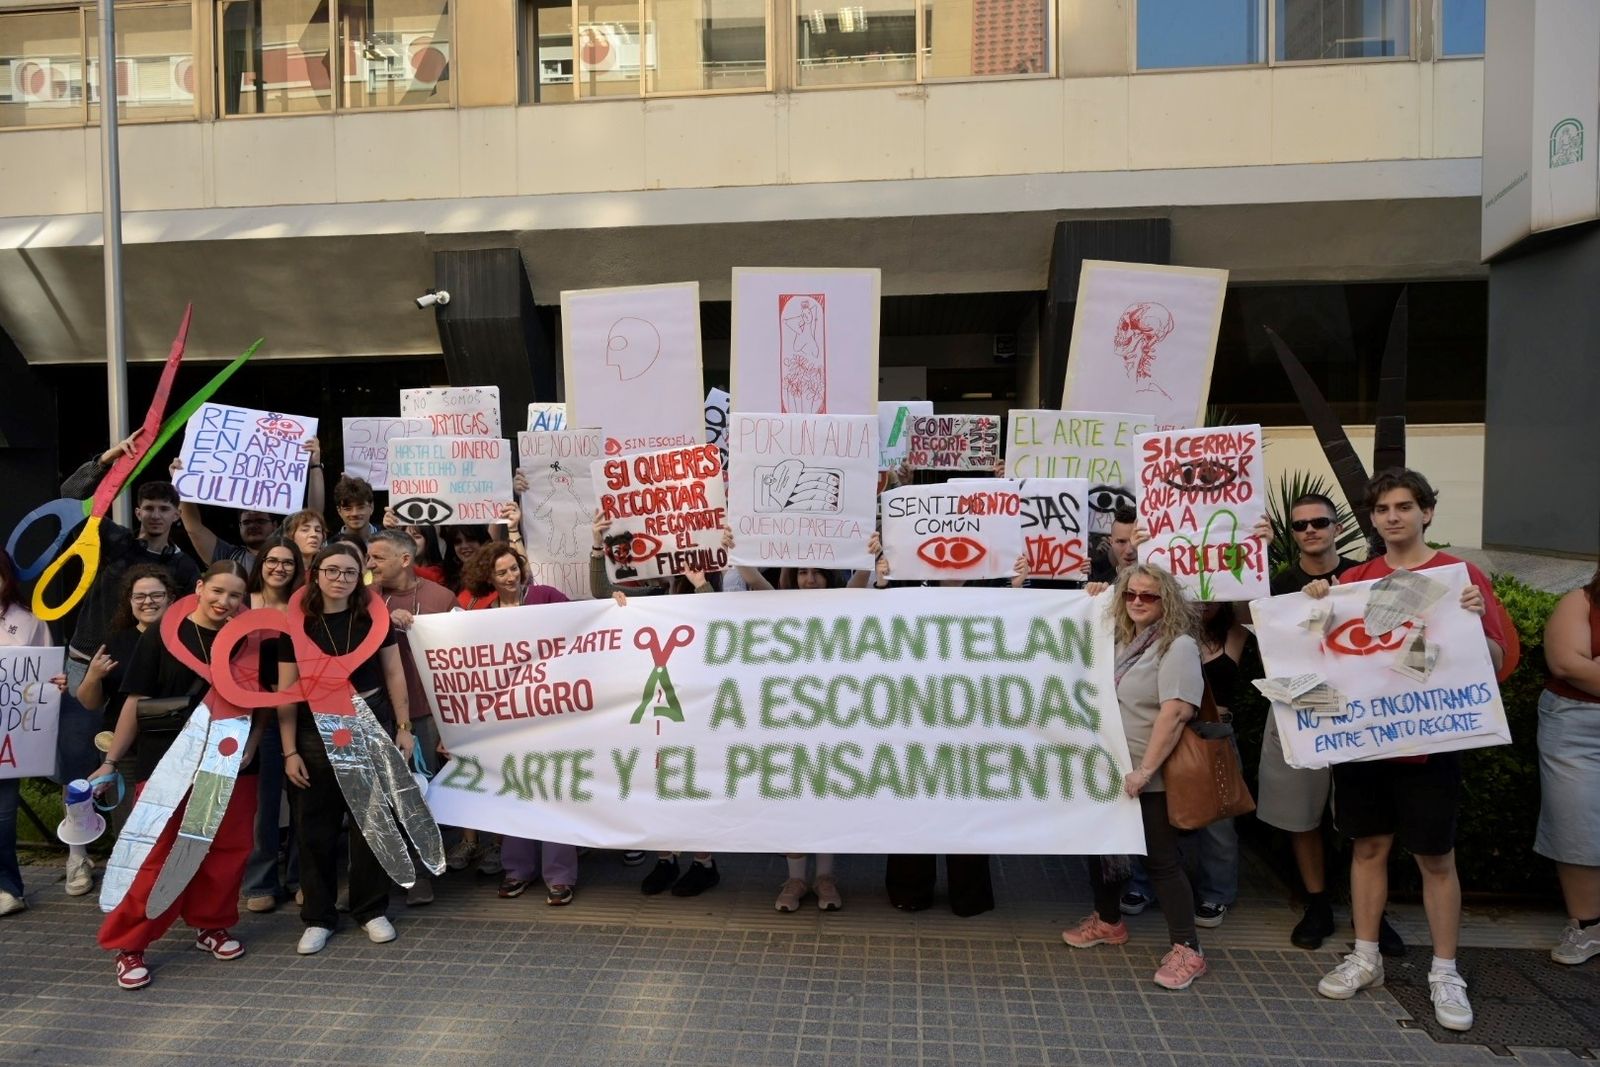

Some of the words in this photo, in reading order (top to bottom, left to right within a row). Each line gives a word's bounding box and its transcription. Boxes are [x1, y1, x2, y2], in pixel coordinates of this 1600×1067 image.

[414, 397, 426, 411] NO
[442, 392, 481, 406] SOMOS
[201, 407, 247, 431] RE
[350, 419, 423, 443] STOP
[428, 412, 489, 435] ORMIGAS
[914, 417, 954, 436] CON
[1014, 416, 1043, 446] EL
[1053, 418, 1105, 447] ARTE
[194, 430, 240, 451] EN
[245, 434, 308, 461] ARTE
[395, 445, 430, 459] HASTA
[433, 445, 446, 460] EL
[451, 440, 500, 460] DINERO
[520, 435, 546, 457] QUE
[551, 434, 572, 457] NO
[574, 434, 600, 457] NOS
[624, 438, 646, 450] SIN
[649, 434, 697, 448] ESCUELA
[740, 418, 784, 455] POR
[790, 419, 817, 456] UN
[823, 421, 871, 459] AULA
[911, 434, 968, 451] RECORTE
[1143, 436, 1171, 463] SI
[1174, 432, 1256, 459] CERRAIS
[187, 450, 233, 474] ES
[232, 453, 306, 482] BORRAR
[391, 461, 411, 477] QUE
[414, 462, 423, 477] TE
[604, 460, 630, 490] SI
[634, 444, 721, 485] QUIERES
[908, 451, 929, 466] NO
[932, 452, 963, 467] HAY
[176, 473, 292, 509] CULTURA
[392, 479, 439, 495] BOLSILLO
[450, 480, 493, 494] NECESITA
[600, 481, 709, 520] RECORTAR
[458, 499, 504, 520] DISEÑO
[645, 508, 726, 535] RECORTATE
[1147, 511, 1175, 539] VA
[1180, 505, 1198, 532] A
[739, 515, 771, 537] QUE
[773, 516, 795, 536] NO
[799, 517, 863, 539] PAREZCA
[914, 517, 980, 535] COMÚN
[675, 531, 698, 550] EL
[760, 541, 791, 560] UNA
[798, 542, 836, 561] LATA
[424, 640, 532, 670] ESCUELAS
[537, 637, 567, 661] DE
[568, 628, 623, 656] ARTE
[703, 614, 1095, 669] DESMANTELAN
[13, 656, 41, 683] UN
[432, 661, 547, 694] ANDALUZAS
[436, 693, 471, 724] EN
[475, 678, 595, 723] PELIGRO
[708, 676, 747, 732] A
[758, 674, 1100, 734] ESCONDIDAS
[1370, 682, 1492, 717] ENCONTRAMOS
[8, 706, 41, 732] DEL
[1314, 730, 1366, 753] ENTRE
[1366, 719, 1416, 748] TANTO
[1419, 712, 1483, 736] RECORTE
[496, 747, 595, 802] ARTE
[610, 744, 641, 802] Y
[656, 744, 712, 801] EL
[725, 742, 1122, 803] PENSAMIENTO
